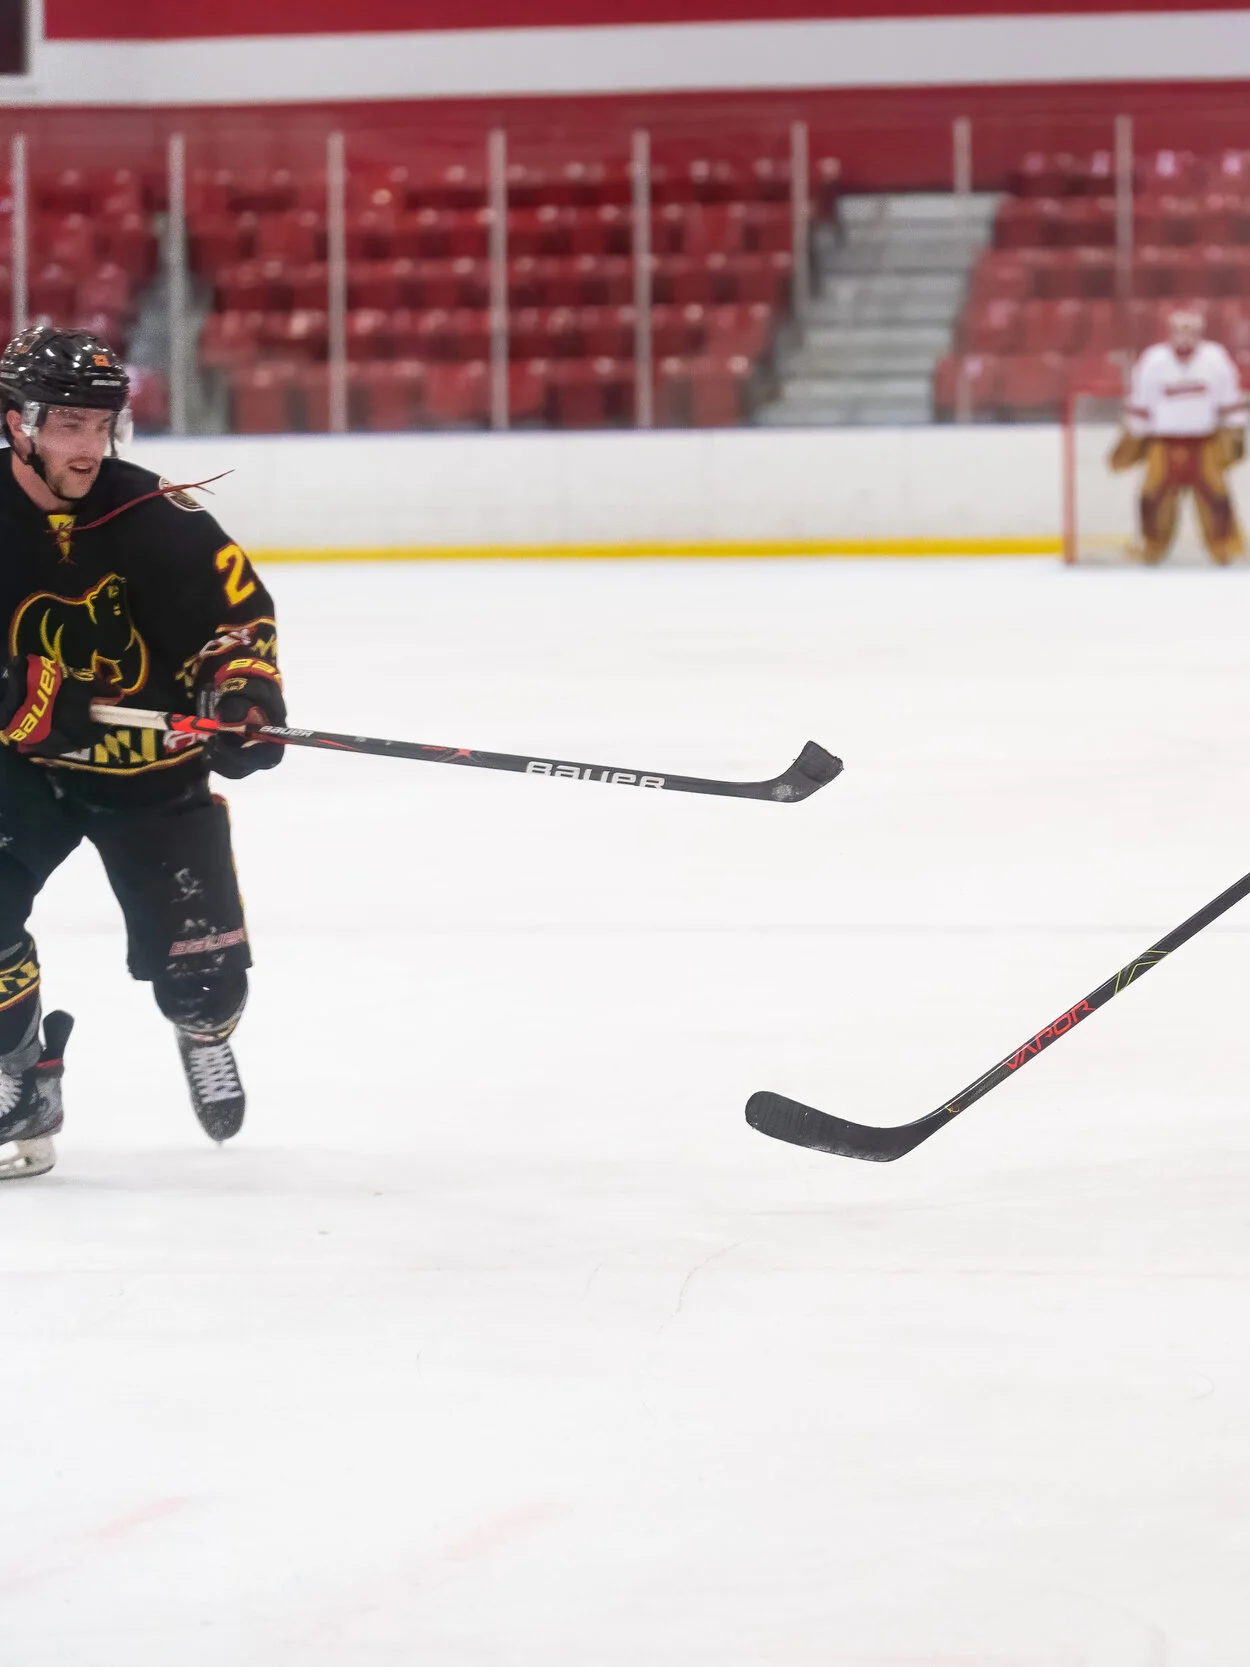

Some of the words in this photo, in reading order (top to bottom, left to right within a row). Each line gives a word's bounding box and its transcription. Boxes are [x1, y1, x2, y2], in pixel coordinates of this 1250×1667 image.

[259, 725, 315, 738] BAUER
[525, 760, 666, 790] BAUER
[1000, 999, 1097, 1070] VAPOR
